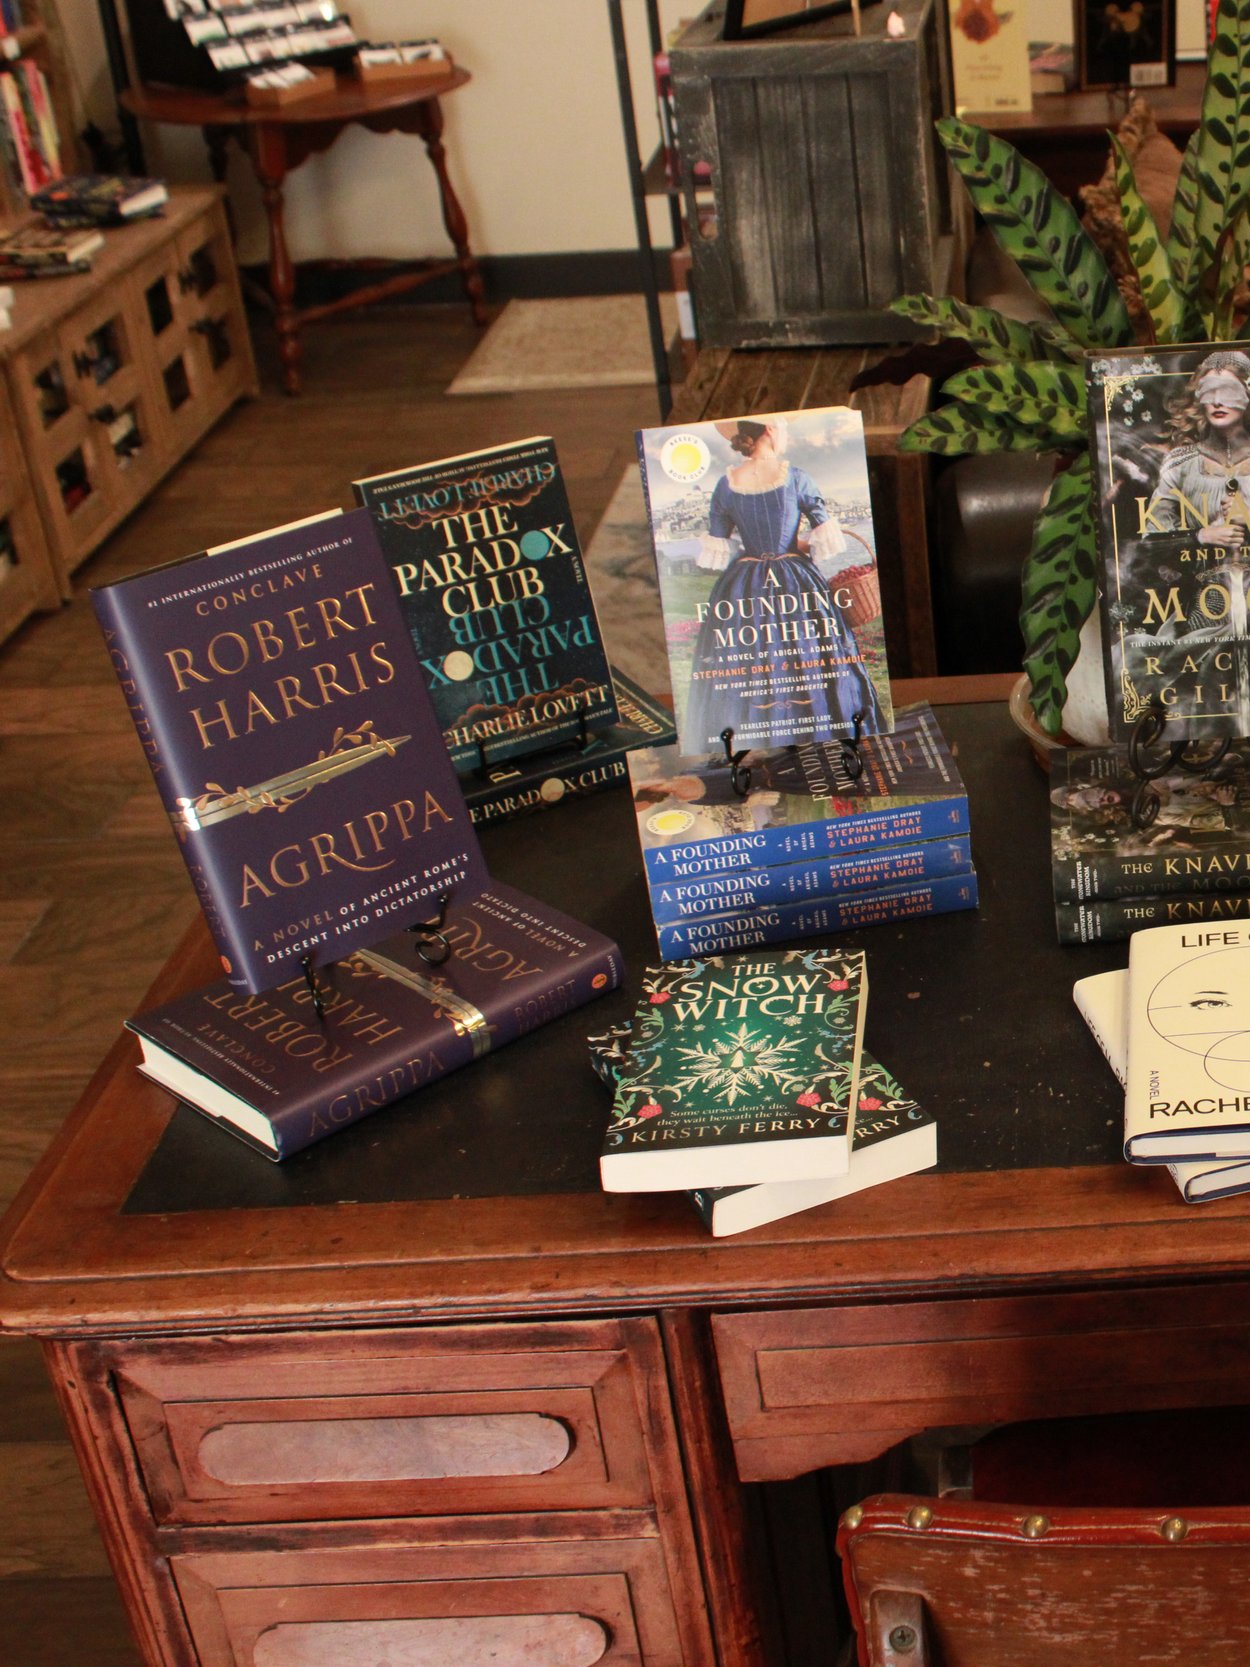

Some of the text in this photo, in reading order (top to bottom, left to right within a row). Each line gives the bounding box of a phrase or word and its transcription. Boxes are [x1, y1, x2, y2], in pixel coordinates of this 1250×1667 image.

[378, 462, 556, 520] CHARLIE LOVETT
[432, 502, 519, 548] THE
[162, 541, 340, 604] INTERNATIONALLY BESTSELLING AUTHOR
[392, 523, 574, 596] PARADOX
[196, 564, 324, 616] CONCLAVE
[762, 567, 782, 588] A
[442, 567, 545, 618] CLUB
[695, 588, 854, 624] FOUNDING
[450, 595, 550, 646] CLUB
[713, 617, 842, 649] MOTHER
[164, 583, 376, 692] ROBERT
[1148, 639, 1182, 648] INSTANT
[1214, 635, 1236, 644] YORK
[692, 654, 866, 680] STEPHANIE DRAY & LAURA KAMOIE
[728, 653, 754, 662] NOVEL
[759, 651, 769, 659] OF
[774, 648, 805, 657] ABIGAIL
[810, 645, 838, 653] ADAMS
[476, 662, 559, 706] THE
[740, 686, 794, 698] AMERICA'S FIRST
[749, 675, 810, 687] TIMES BESTSELLING
[190, 641, 397, 750] HARRIS
[529, 685, 608, 724] LOVETT
[740, 716, 816, 730] FEARLESS FIRST
[772, 724, 828, 736] FORCE BEHIND TWO
[579, 761, 626, 788] CLUB
[827, 816, 922, 839] STEPHANIE DRAY
[840, 826, 922, 847] LAURA KAMOIE
[240, 790, 454, 908] AGRIPPA
[654, 835, 766, 864] A FOUNDING
[674, 853, 752, 876] MOTHER
[830, 858, 924, 878] STEPHANIE DRAY
[844, 866, 925, 886] LAURA KAMOIE
[1121, 863, 1153, 874] THE
[254, 852, 468, 950] A NOVEL OF ANCIENT ROME'S
[660, 874, 770, 903] A FOUNDING
[267, 870, 467, 964] DESCENT INTO DICTATORSHIP
[678, 892, 756, 915] MOTHER
[840, 895, 932, 916] STEPHANIE DRAY
[852, 904, 934, 924] LAURA KAMOIE
[1124, 907, 1155, 919] THE
[472, 901, 578, 958] A NOVEL OF ANCIENT
[520, 912, 586, 948] DESCENT INTO
[670, 913, 780, 944] A FOUNDING
[1181, 928, 1240, 948] LIFE
[690, 932, 766, 955] MOTHER
[732, 962, 776, 976] THE
[678, 974, 824, 1003] SNOW
[672, 994, 826, 1023] WITCH
[203, 991, 354, 1074] ROBERT
[196, 1023, 276, 1074] CONCLAVE
[309, 1050, 445, 1138] AGRIPPA
[1150, 1078, 1160, 1100] NOVEL
[656, 1110, 798, 1127] they wait beneath the ice...
[670, 1104, 765, 1118] Some curses don't
[632, 1118, 821, 1143] KIRSTY FERRY
